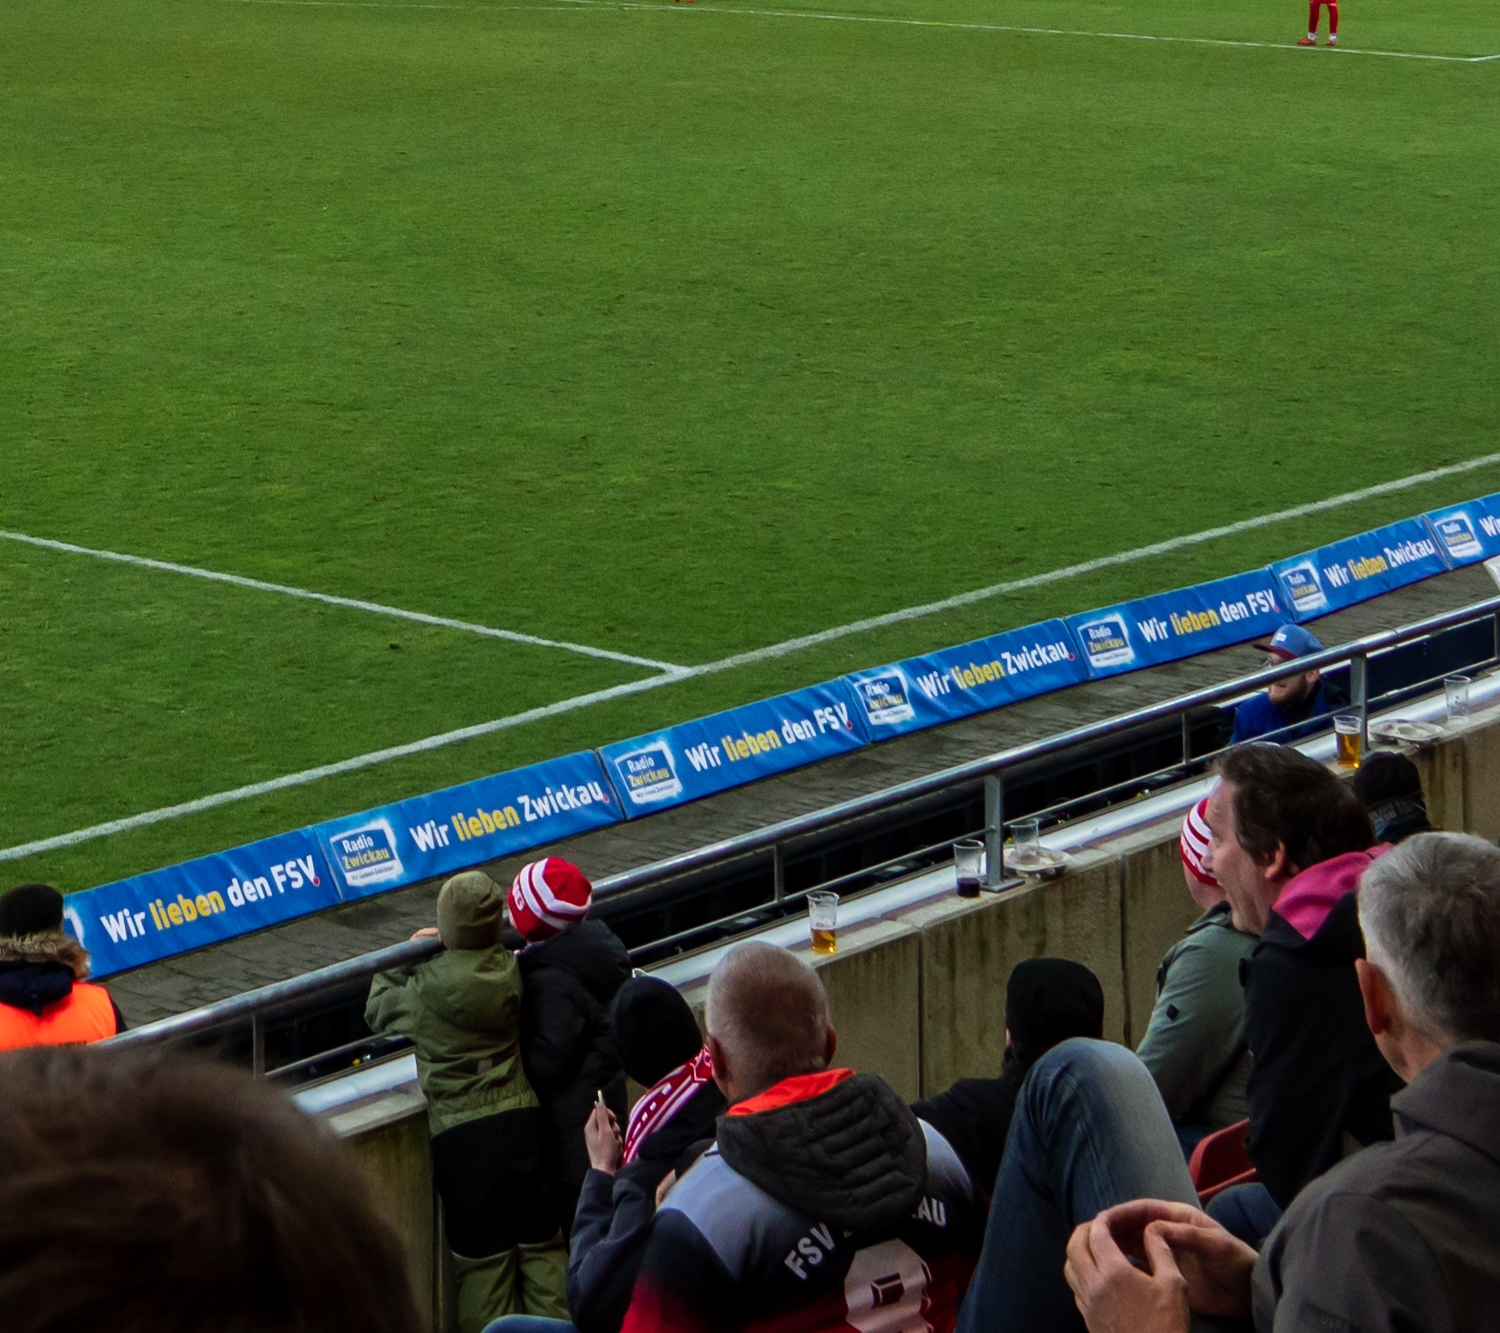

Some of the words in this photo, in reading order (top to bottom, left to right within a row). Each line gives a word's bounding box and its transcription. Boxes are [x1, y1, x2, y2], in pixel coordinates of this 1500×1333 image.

[1087, 625, 1112, 640] Radio
[1137, 617, 1168, 644] Wir
[1169, 609, 1221, 637] lieben
[1219, 601, 1249, 624] den
[917, 667, 951, 699] Wir
[952, 657, 1005, 690] lieben
[626, 754, 656, 773] Radio
[684, 739, 723, 772] Wir
[722, 726, 782, 764] lieben
[781, 715, 817, 744] den
[341, 833, 375, 854] Radio
[408, 818, 451, 853] Wir
[450, 802, 522, 843] lieben
[341, 847, 391, 870] Zwickau
[100, 906, 147, 945] Wir
[149, 888, 226, 933] lieben
[226, 871, 269, 909] den
[783, 1222, 836, 1281] FSV
